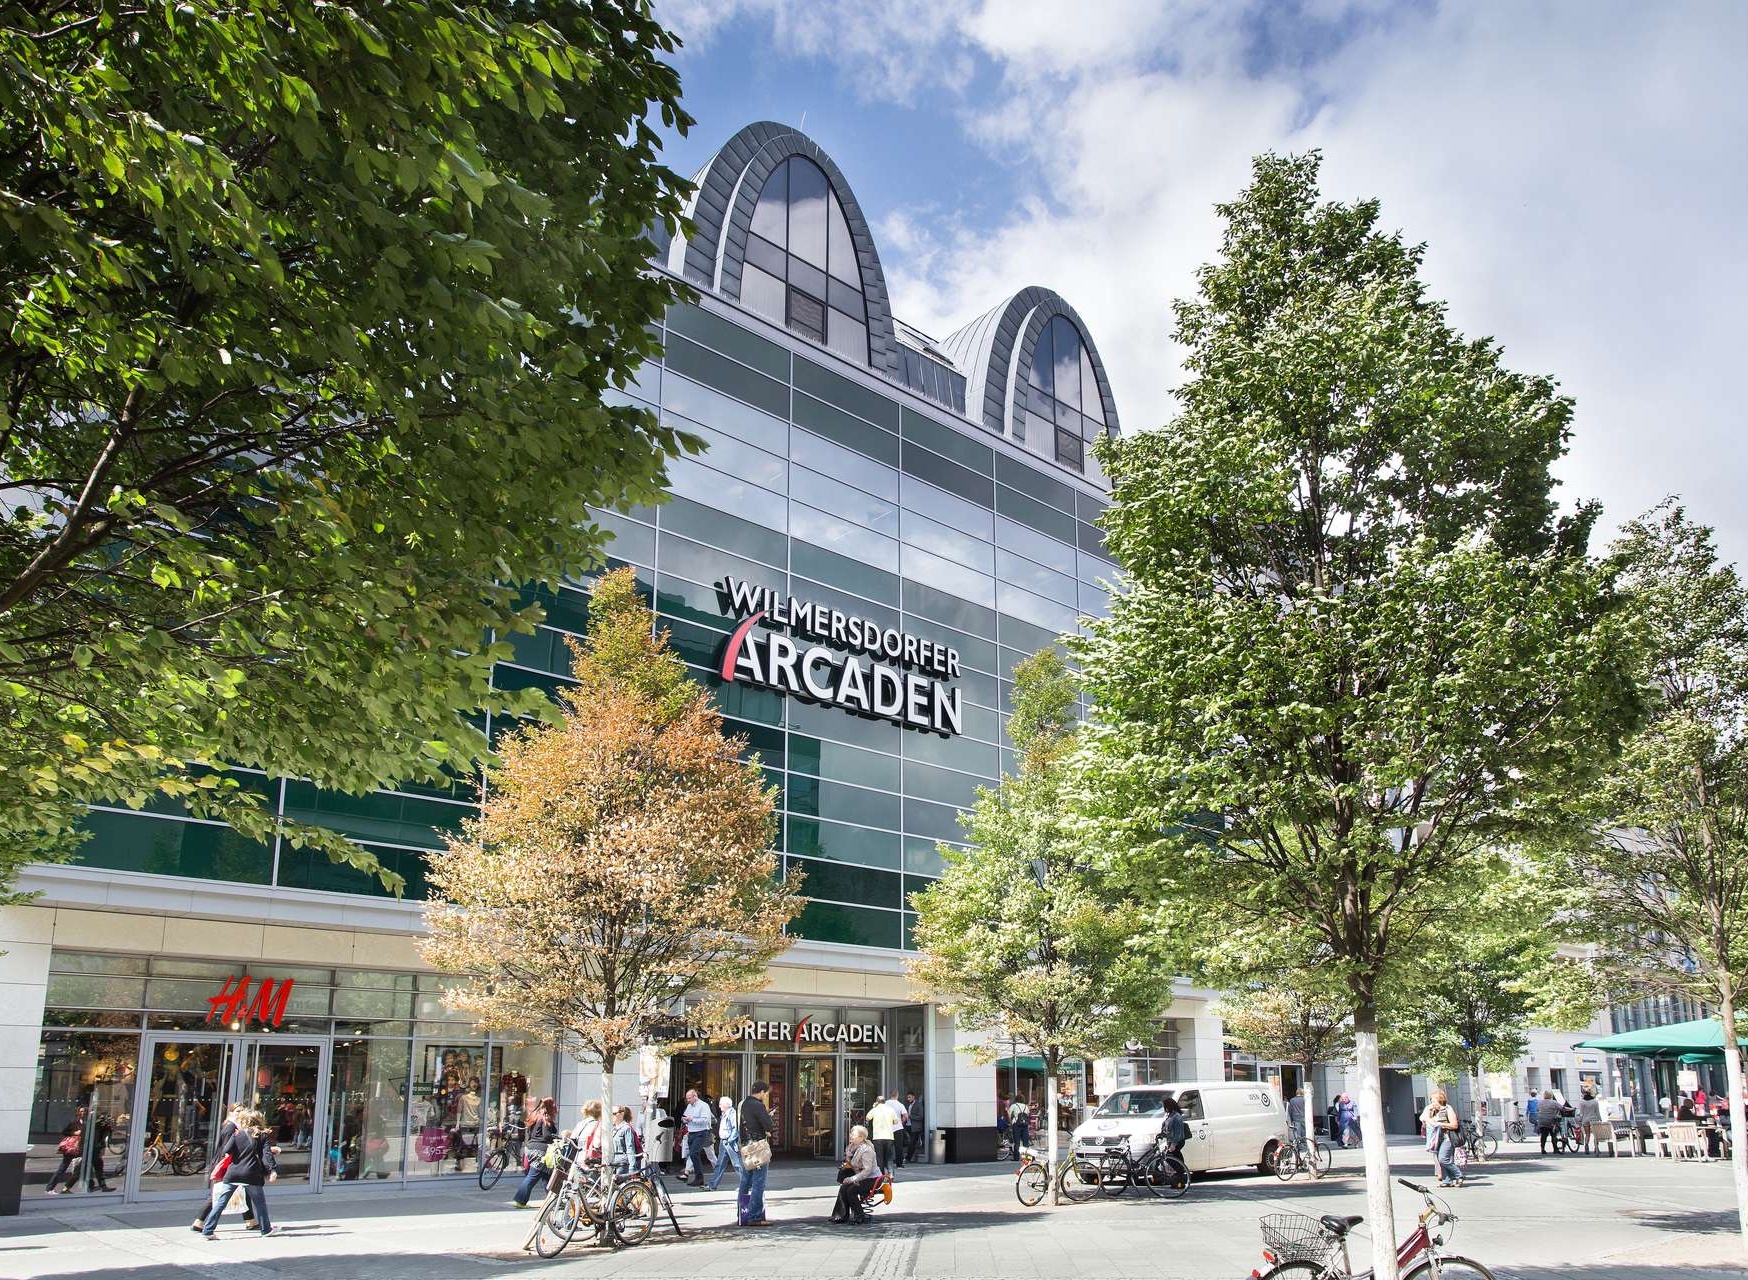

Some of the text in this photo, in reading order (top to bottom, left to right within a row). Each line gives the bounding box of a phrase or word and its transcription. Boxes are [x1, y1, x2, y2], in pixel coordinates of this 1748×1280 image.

[726, 576, 961, 677] WILMERSDORFER
[721, 611, 962, 735] ARCADEN
[205, 975, 295, 1027] H&M
[794, 1016, 887, 1043] ARCADEN
